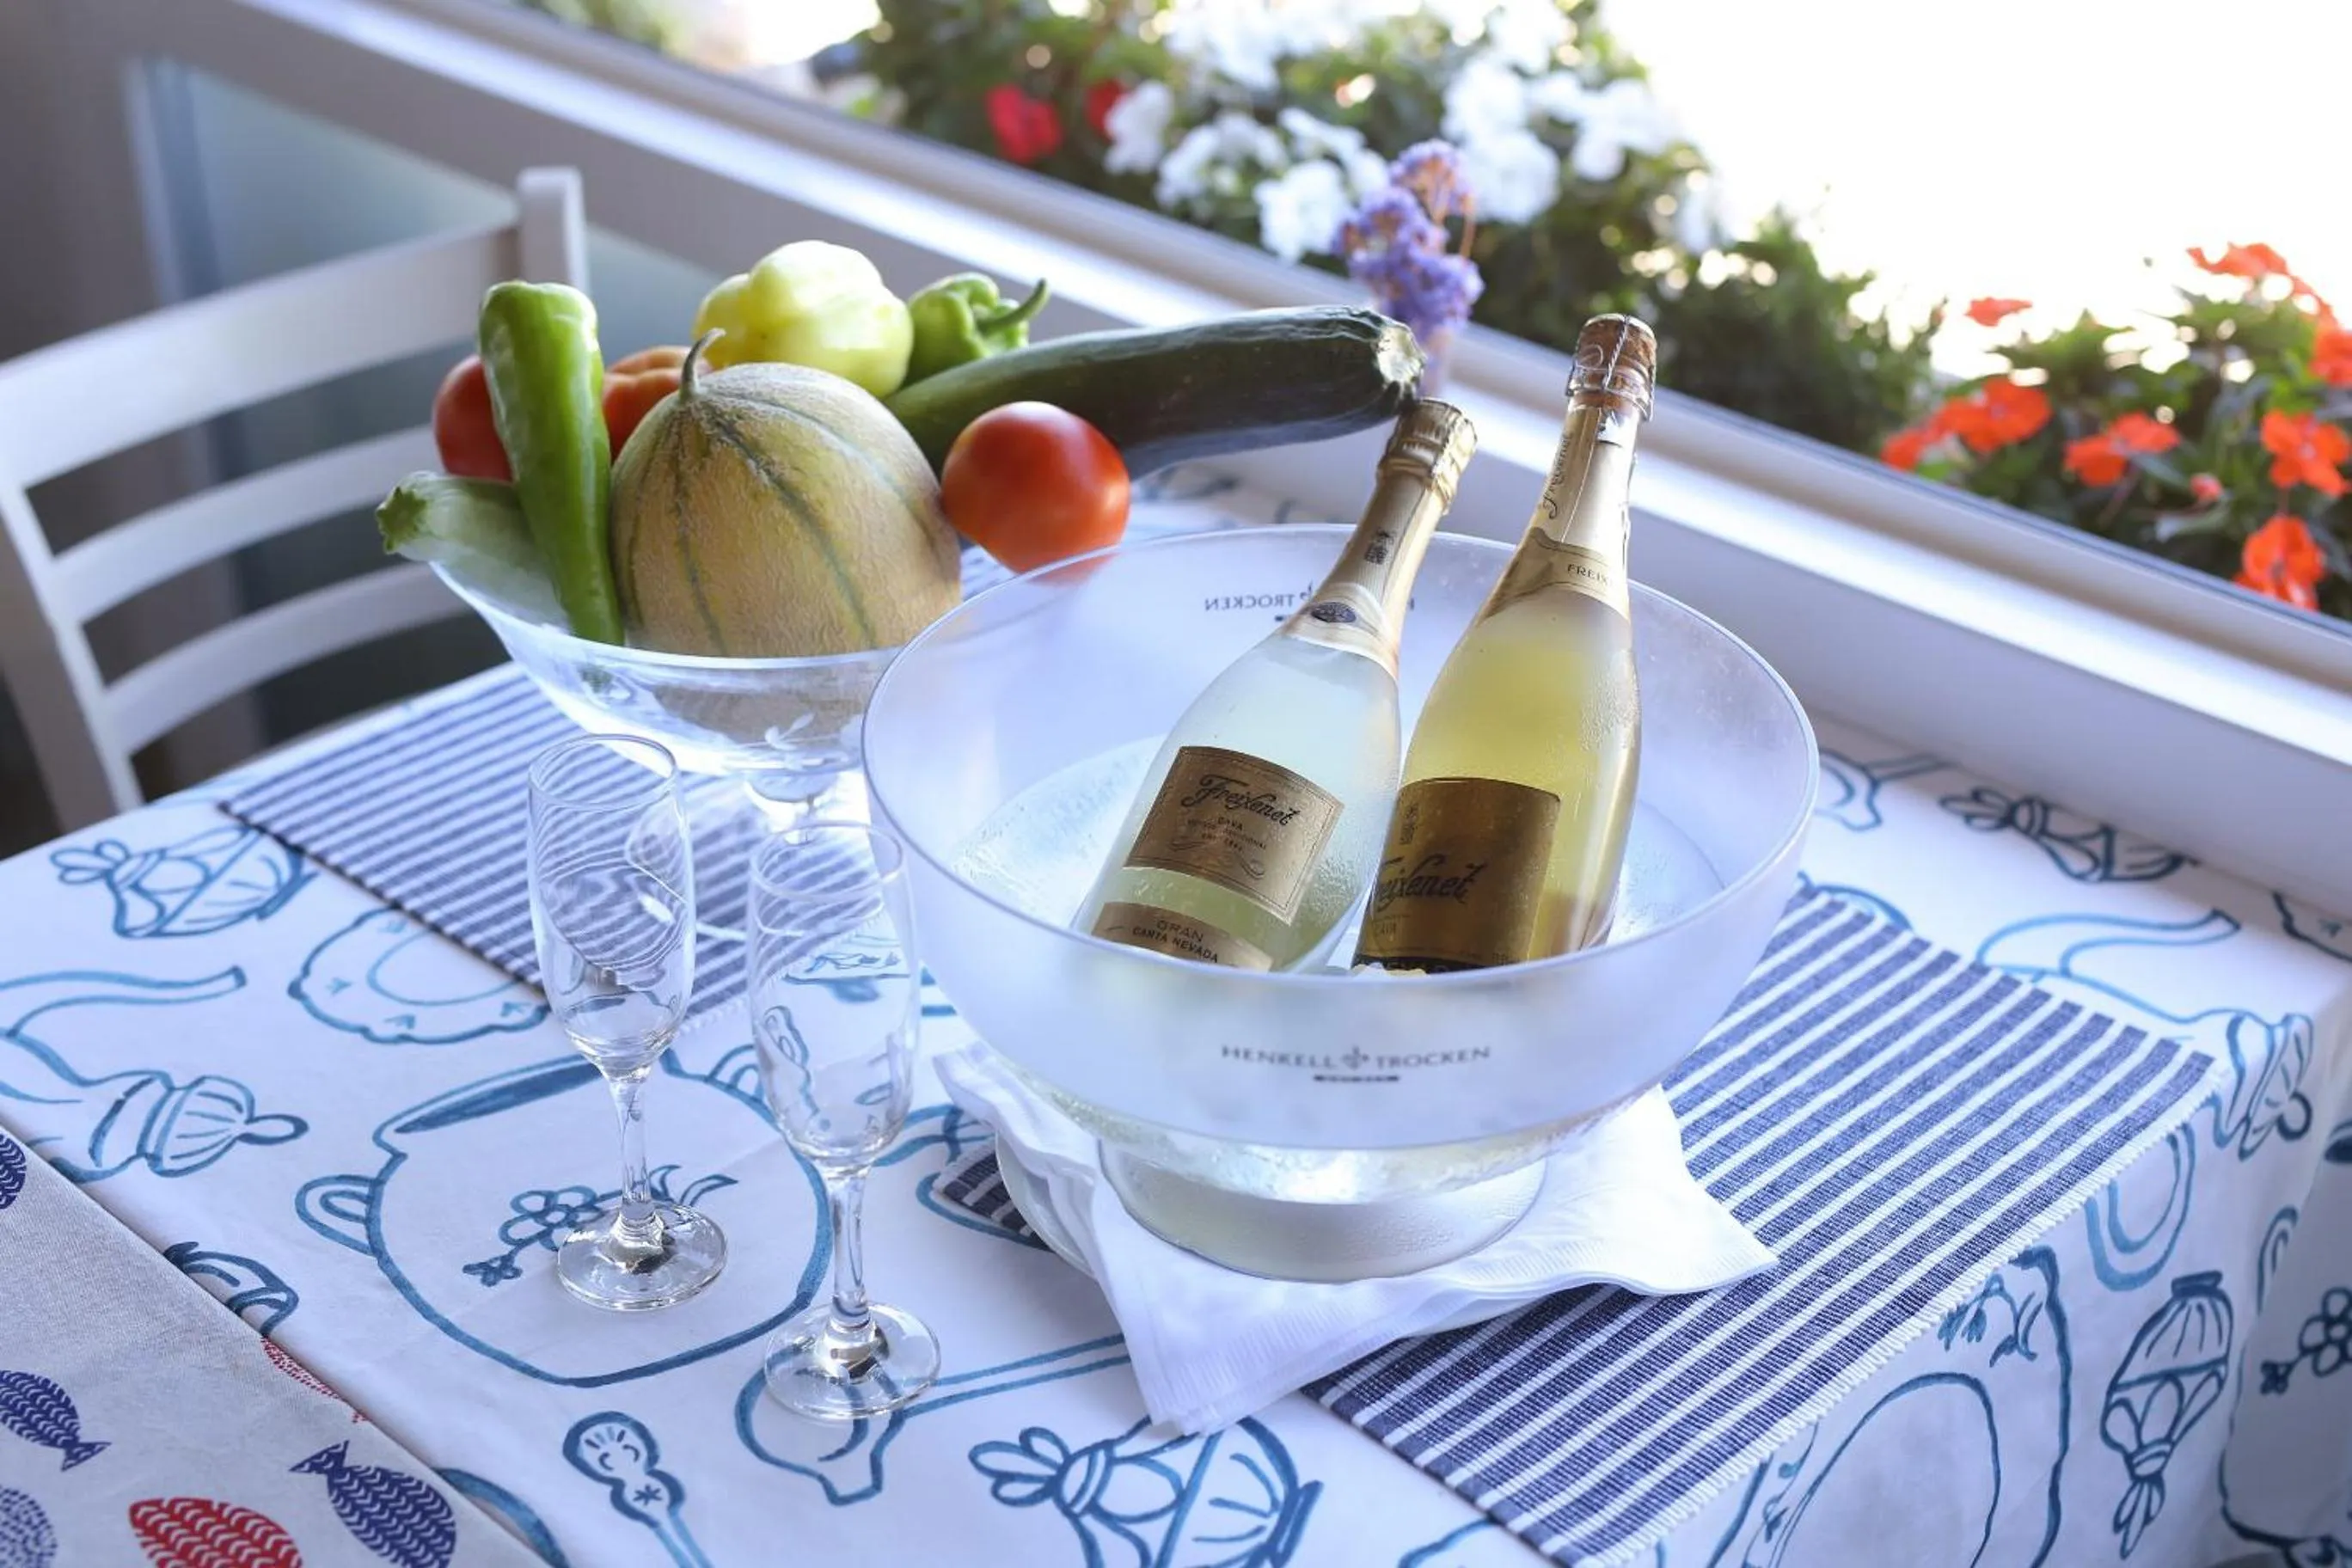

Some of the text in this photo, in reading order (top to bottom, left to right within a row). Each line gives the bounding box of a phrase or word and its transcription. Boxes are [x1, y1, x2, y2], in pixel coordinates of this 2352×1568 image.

[1181, 774, 1301, 826] Freixenet
[1157, 920, 1204, 942] GRAN
[1172, 937, 1218, 964] NEVADA
[1222, 1044, 1491, 1069] HENKELL TROCKEN
